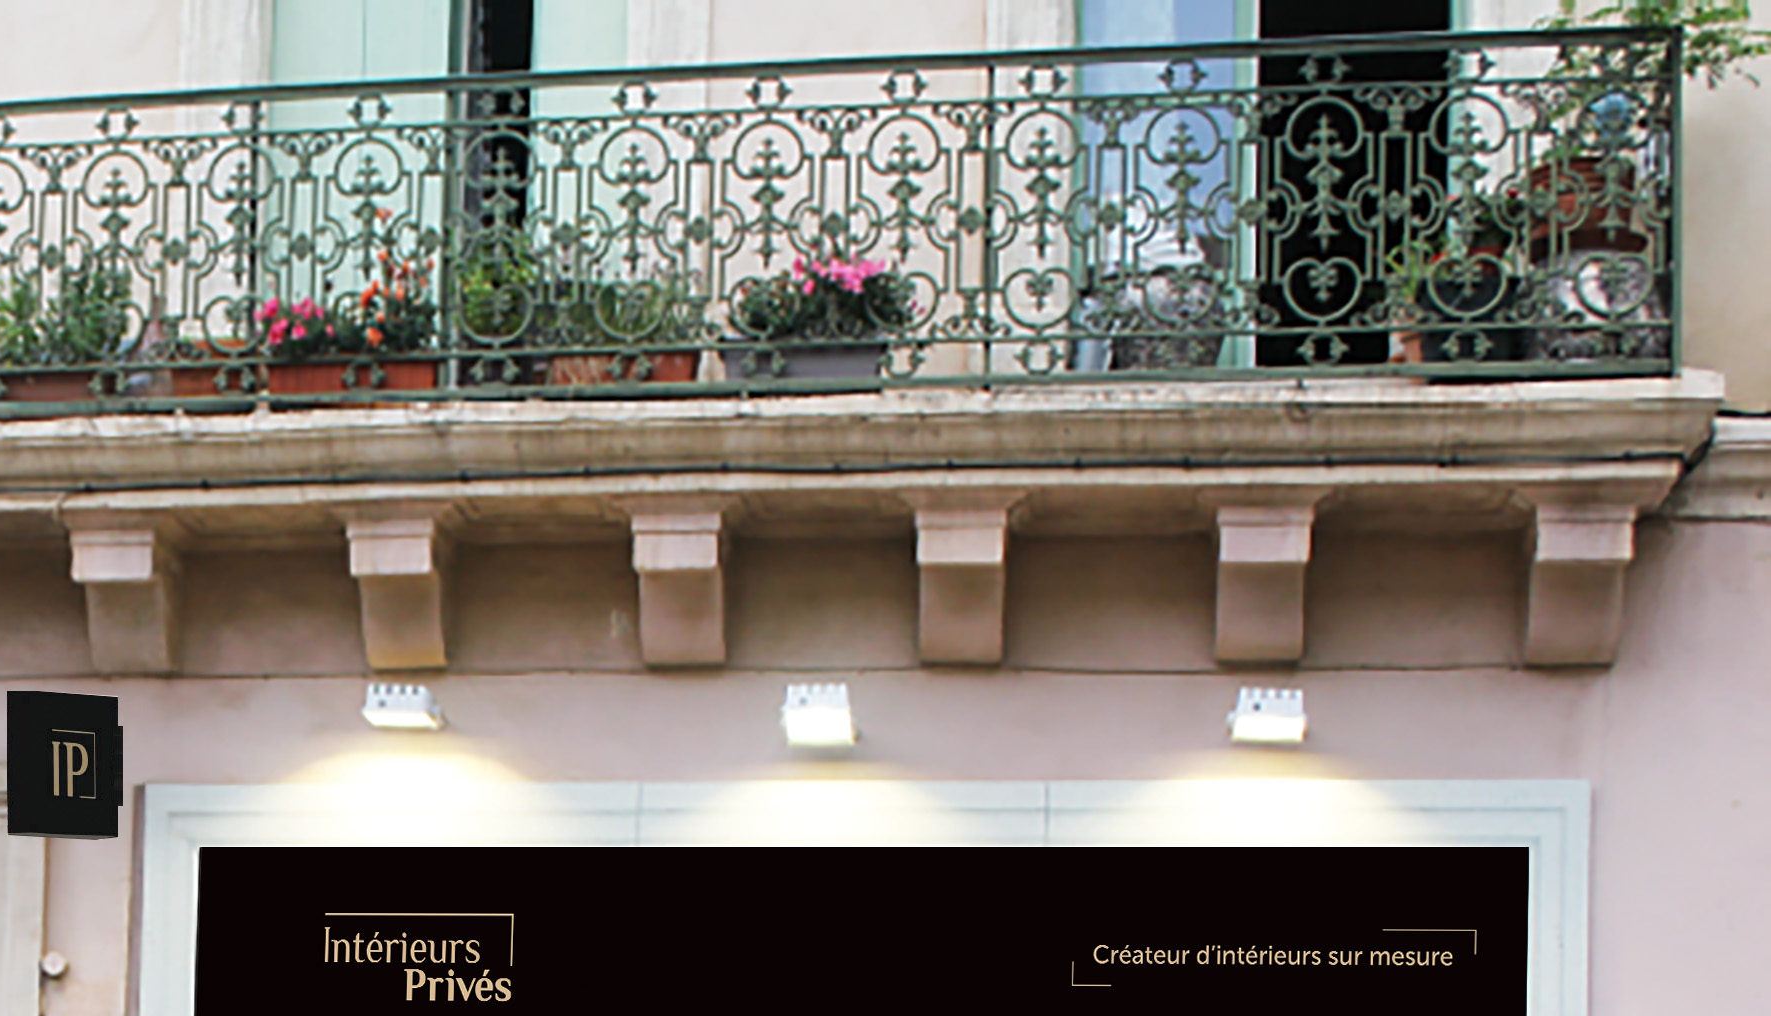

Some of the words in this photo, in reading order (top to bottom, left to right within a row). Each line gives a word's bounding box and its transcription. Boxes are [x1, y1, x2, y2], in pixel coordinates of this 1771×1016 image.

[51, 741, 89, 798] IP
[324, 926, 481, 964] Intérieurs
[1093, 944, 1190, 965] Créateur
[1328, 949, 1363, 966] sur
[1370, 949, 1454, 967] mesure
[403, 968, 513, 1002] Privés
